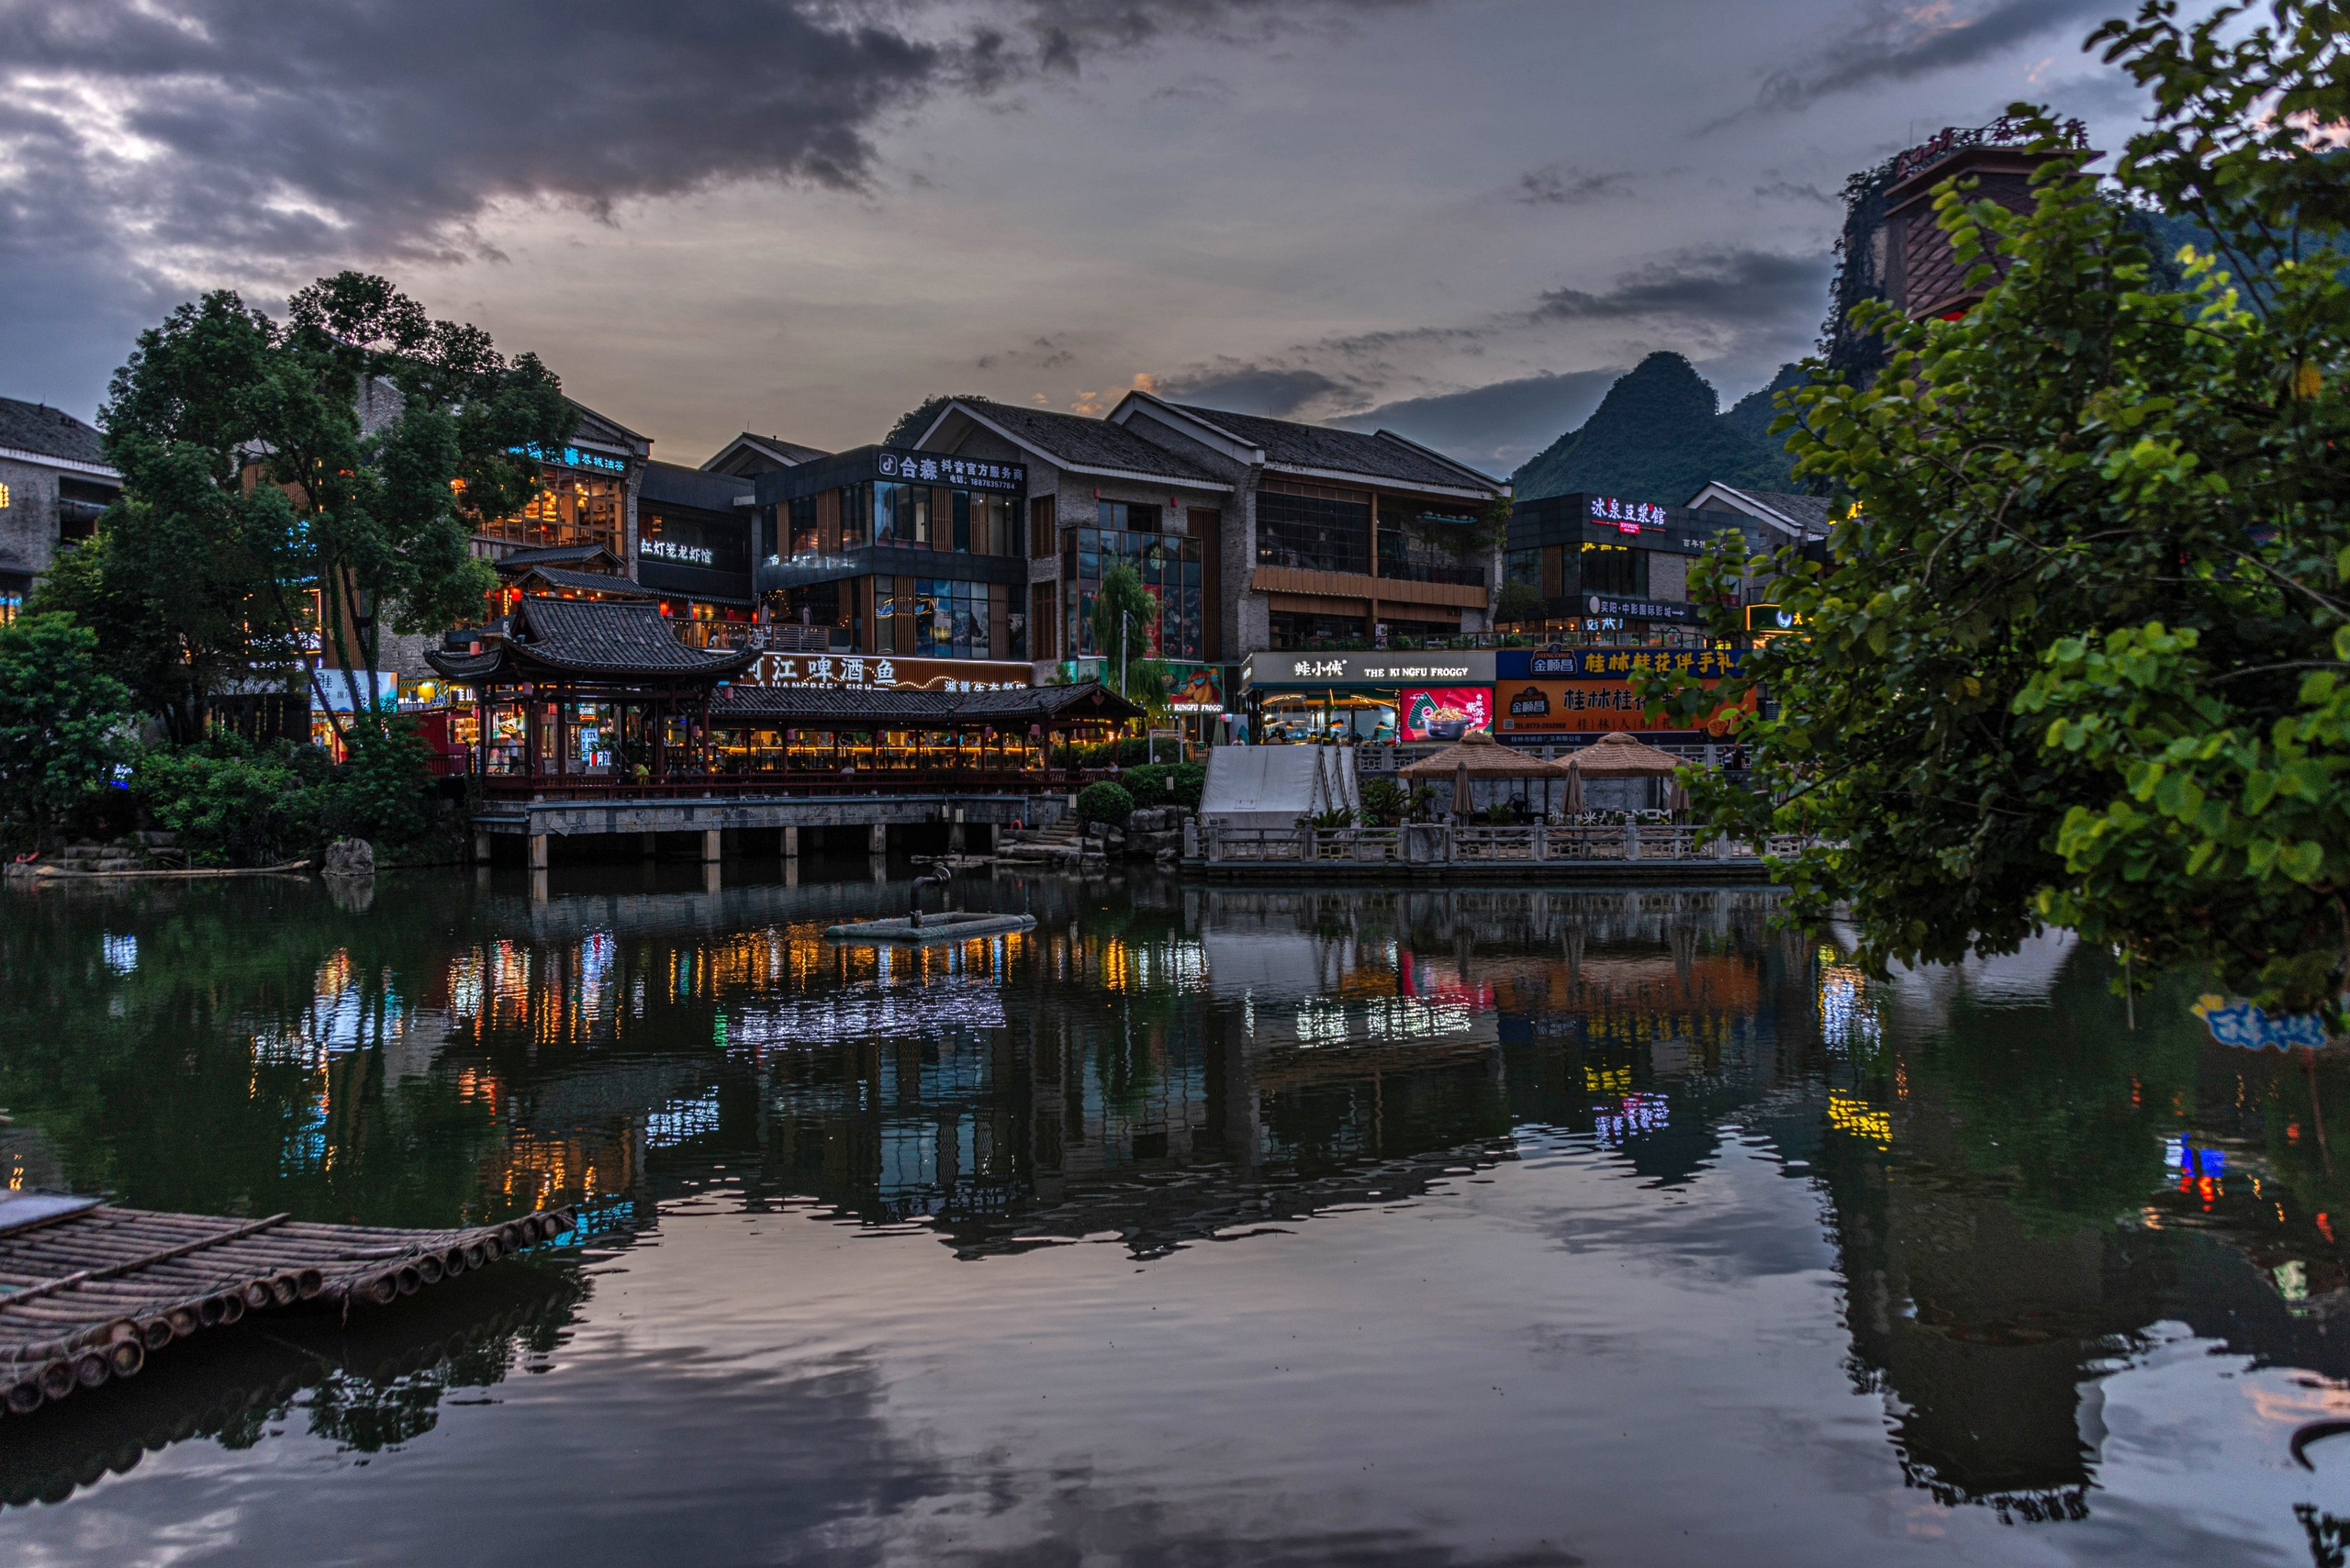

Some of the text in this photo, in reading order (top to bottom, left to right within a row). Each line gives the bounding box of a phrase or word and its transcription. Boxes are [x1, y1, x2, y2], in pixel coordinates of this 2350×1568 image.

[900, 456, 1024, 481] 合森 抖音官方服务商
[641, 538, 712, 564] 红灯笼龙虾馆
[1534, 658, 1573, 672] 金顺昌
[1584, 651, 1735, 675] 桂林桂花伴手礼
[1364, 668, 1384, 678] THE
[1431, 667, 1469, 677] FROGGY
[1174, 703, 1199, 711] KUNGFU
[1201, 704, 1224, 712] FROGGY
[1511, 700, 1546, 713] 金顺昌
